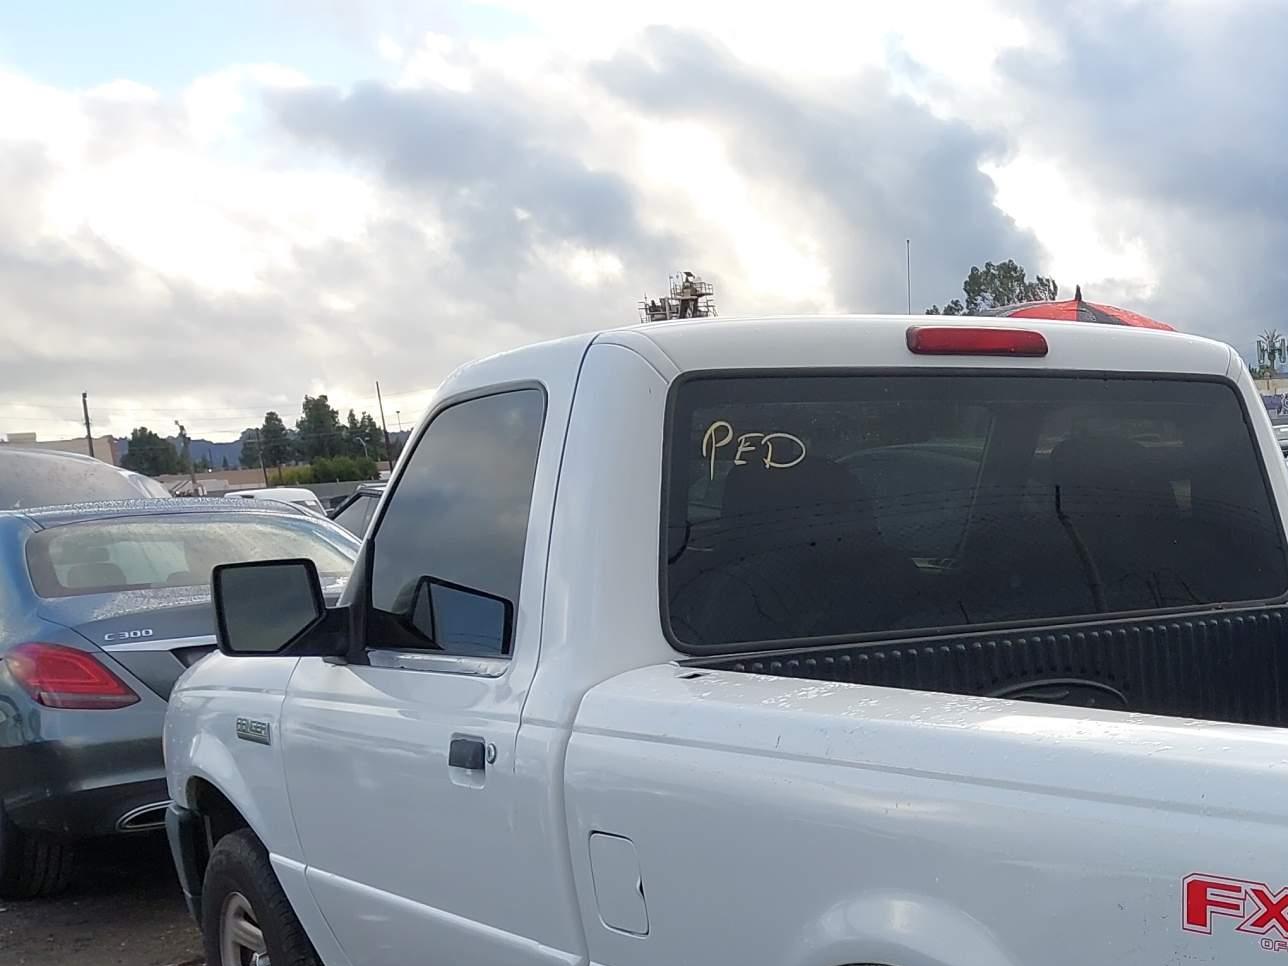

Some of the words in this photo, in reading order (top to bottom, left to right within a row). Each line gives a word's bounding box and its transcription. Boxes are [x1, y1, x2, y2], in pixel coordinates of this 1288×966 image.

[702, 420, 806, 481] PED
[104, 633, 113, 641] C
[119, 628, 154, 640] 300
